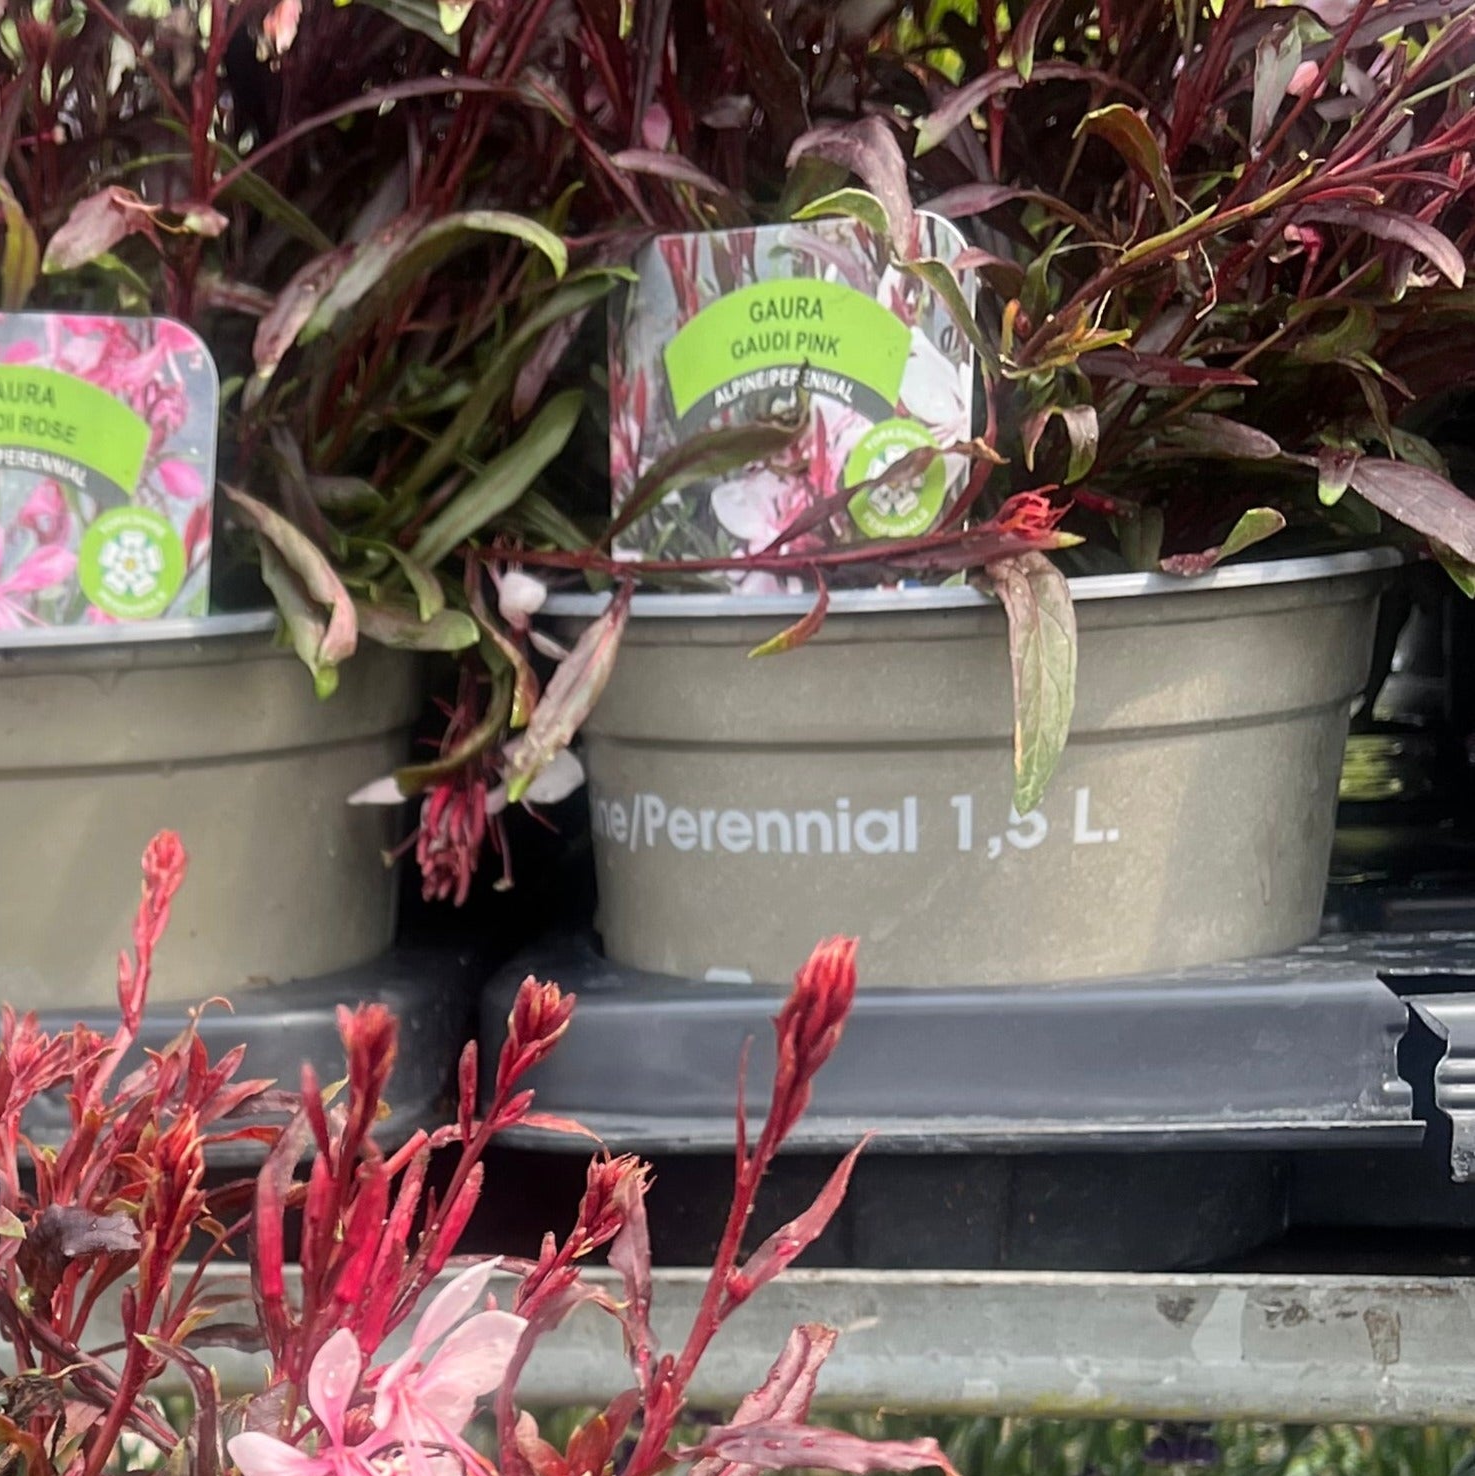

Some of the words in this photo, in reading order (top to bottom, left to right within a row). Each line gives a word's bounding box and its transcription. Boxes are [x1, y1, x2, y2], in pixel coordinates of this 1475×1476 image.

[749, 297, 823, 324] GAURA
[731, 331, 791, 360] GAUDI
[795, 331, 841, 358] PINK
[18, 416, 78, 445] ROSE
[951, 793, 1048, 859] 1,5
[1074, 785, 1119, 844] L.
